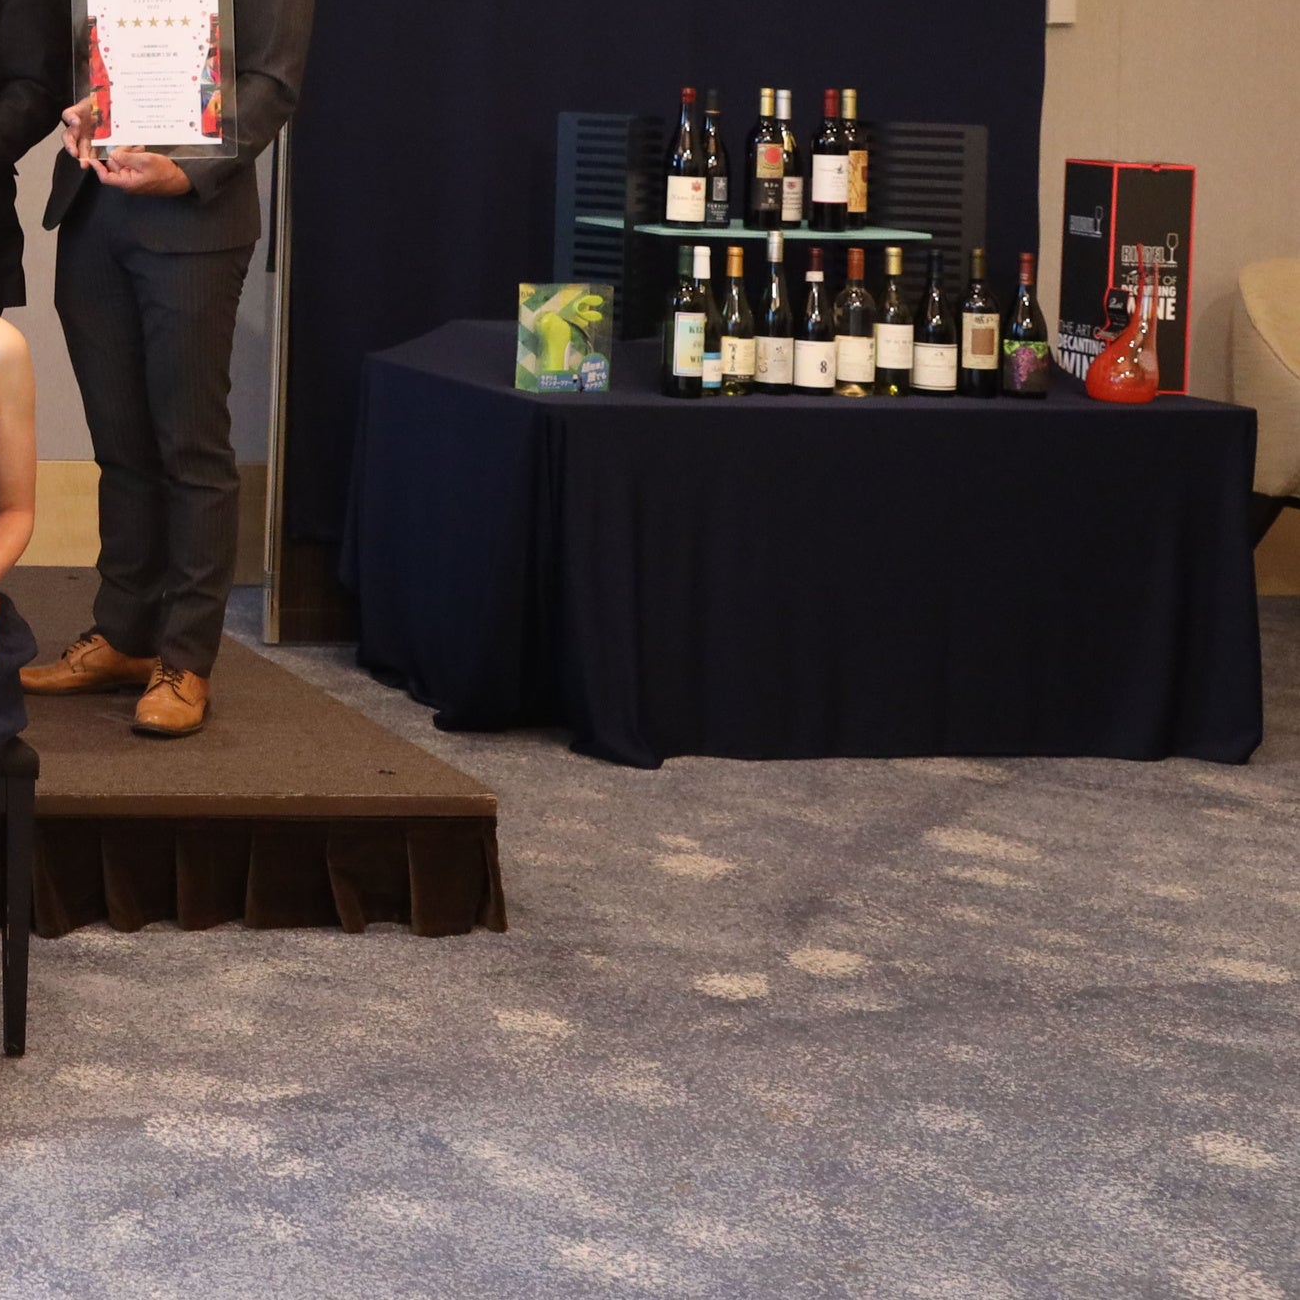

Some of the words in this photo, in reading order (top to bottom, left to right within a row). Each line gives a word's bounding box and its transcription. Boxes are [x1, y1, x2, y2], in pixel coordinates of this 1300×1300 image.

[1121, 245, 1166, 264] RIDEL
[1057, 332, 1106, 356] DECANTING
[820, 360, 828, 374] 8
[1057, 349, 1096, 383] WIN
